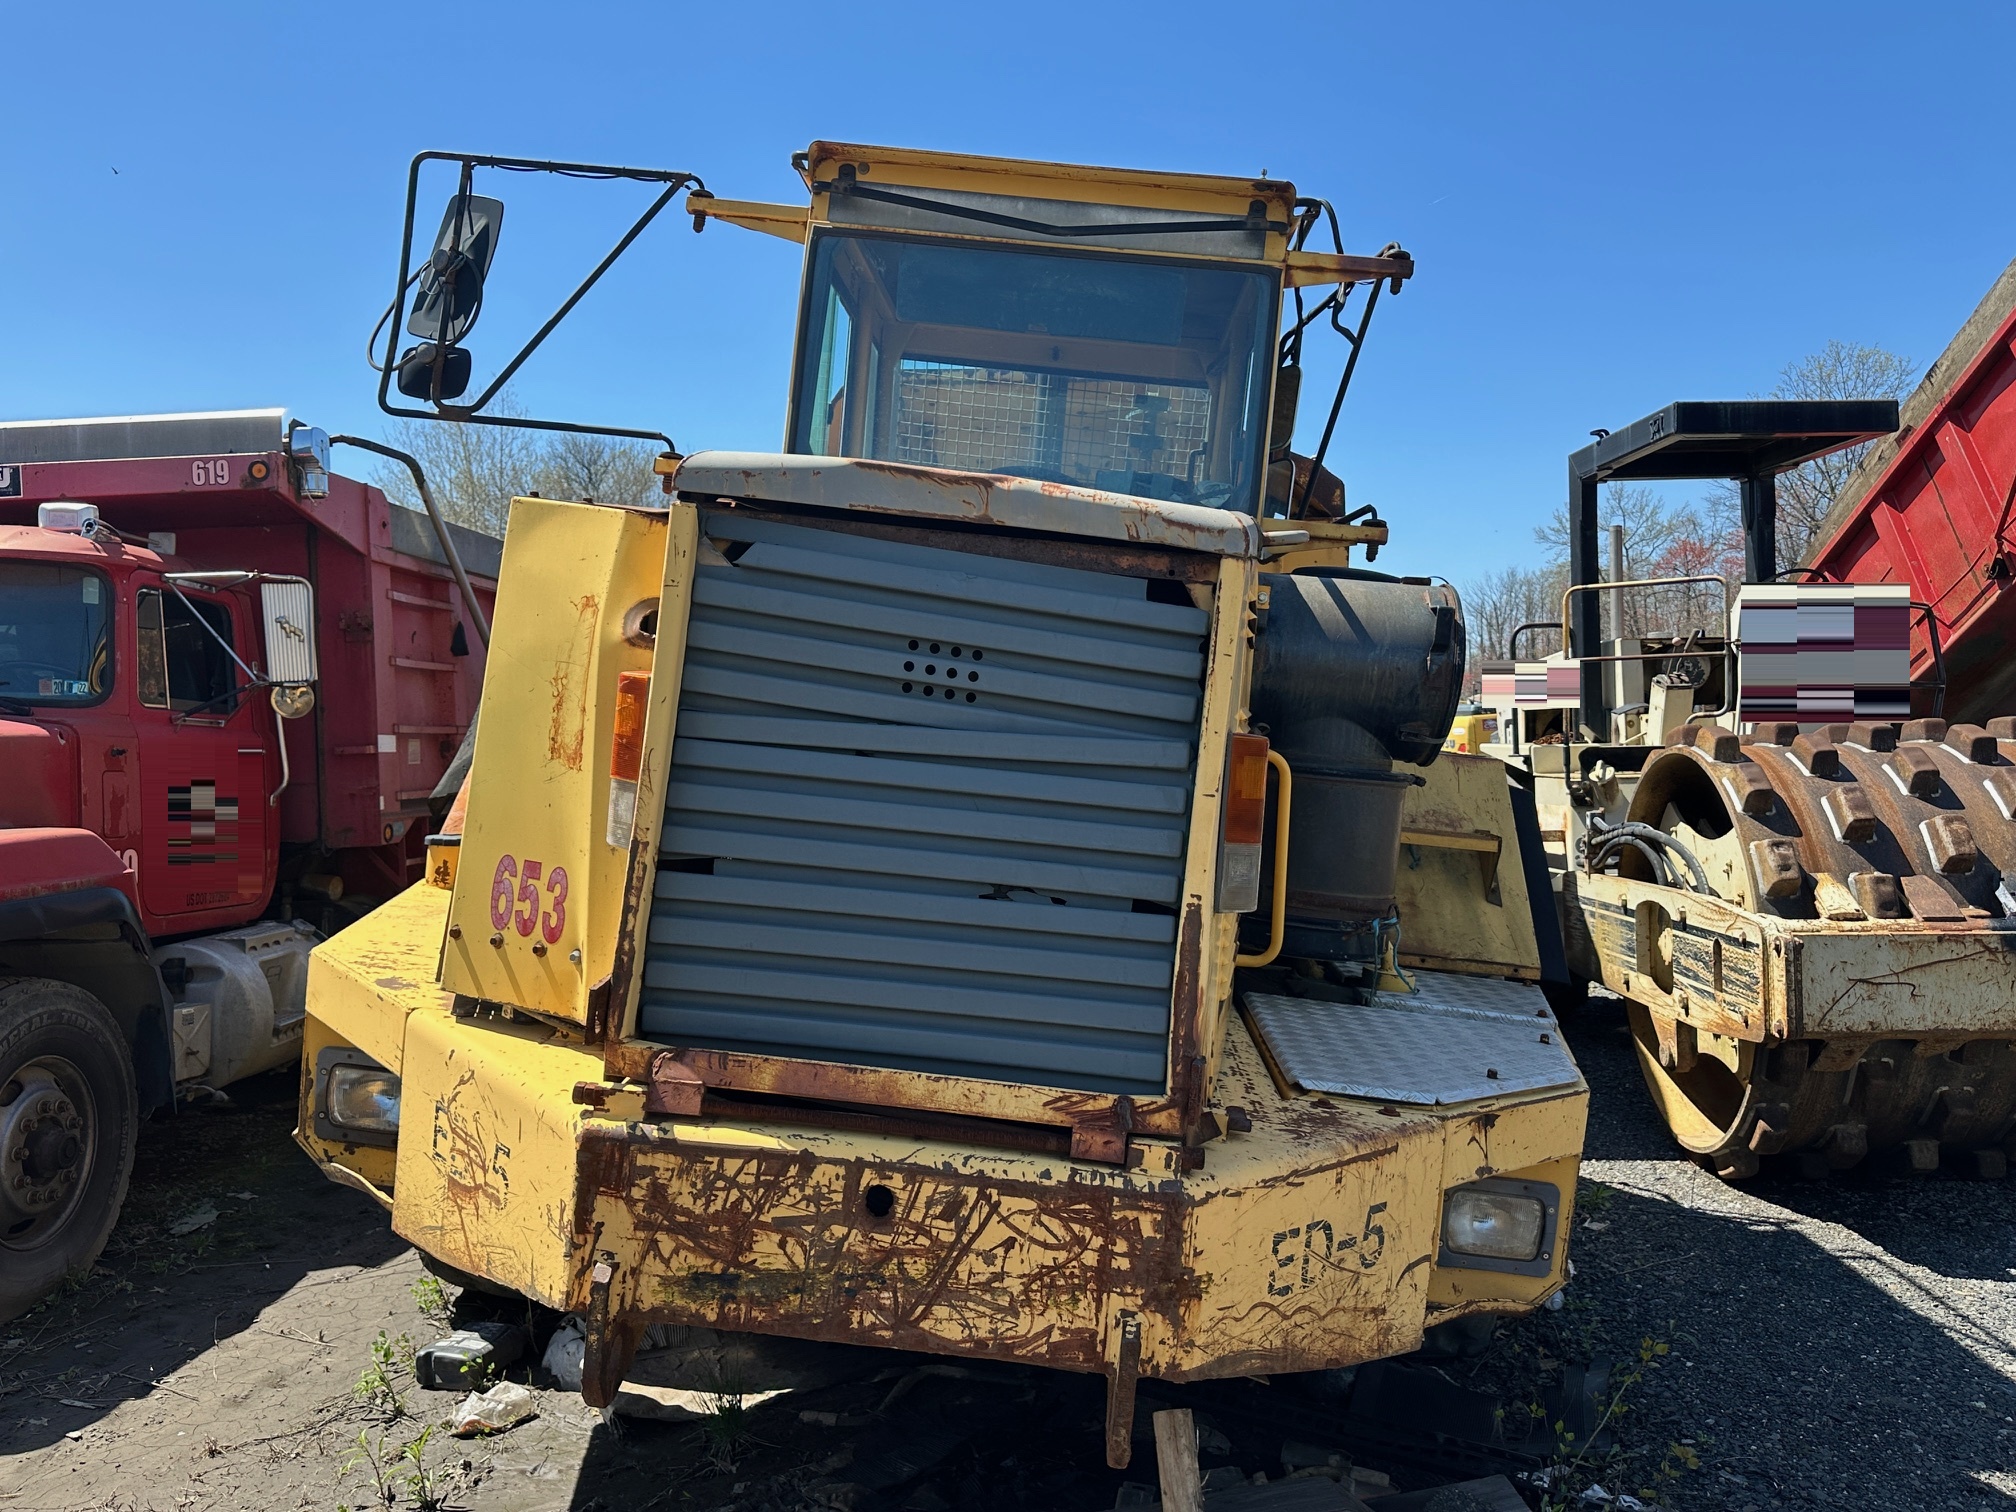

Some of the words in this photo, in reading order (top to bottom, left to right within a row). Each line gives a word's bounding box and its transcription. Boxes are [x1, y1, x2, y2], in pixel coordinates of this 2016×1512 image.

[191, 459, 230, 486] 619
[186, 893, 194, 907] US
[195, 892, 207, 906] DOT
[490, 854, 568, 944] 653
[1267, 1201, 1388, 1297] ED-5
